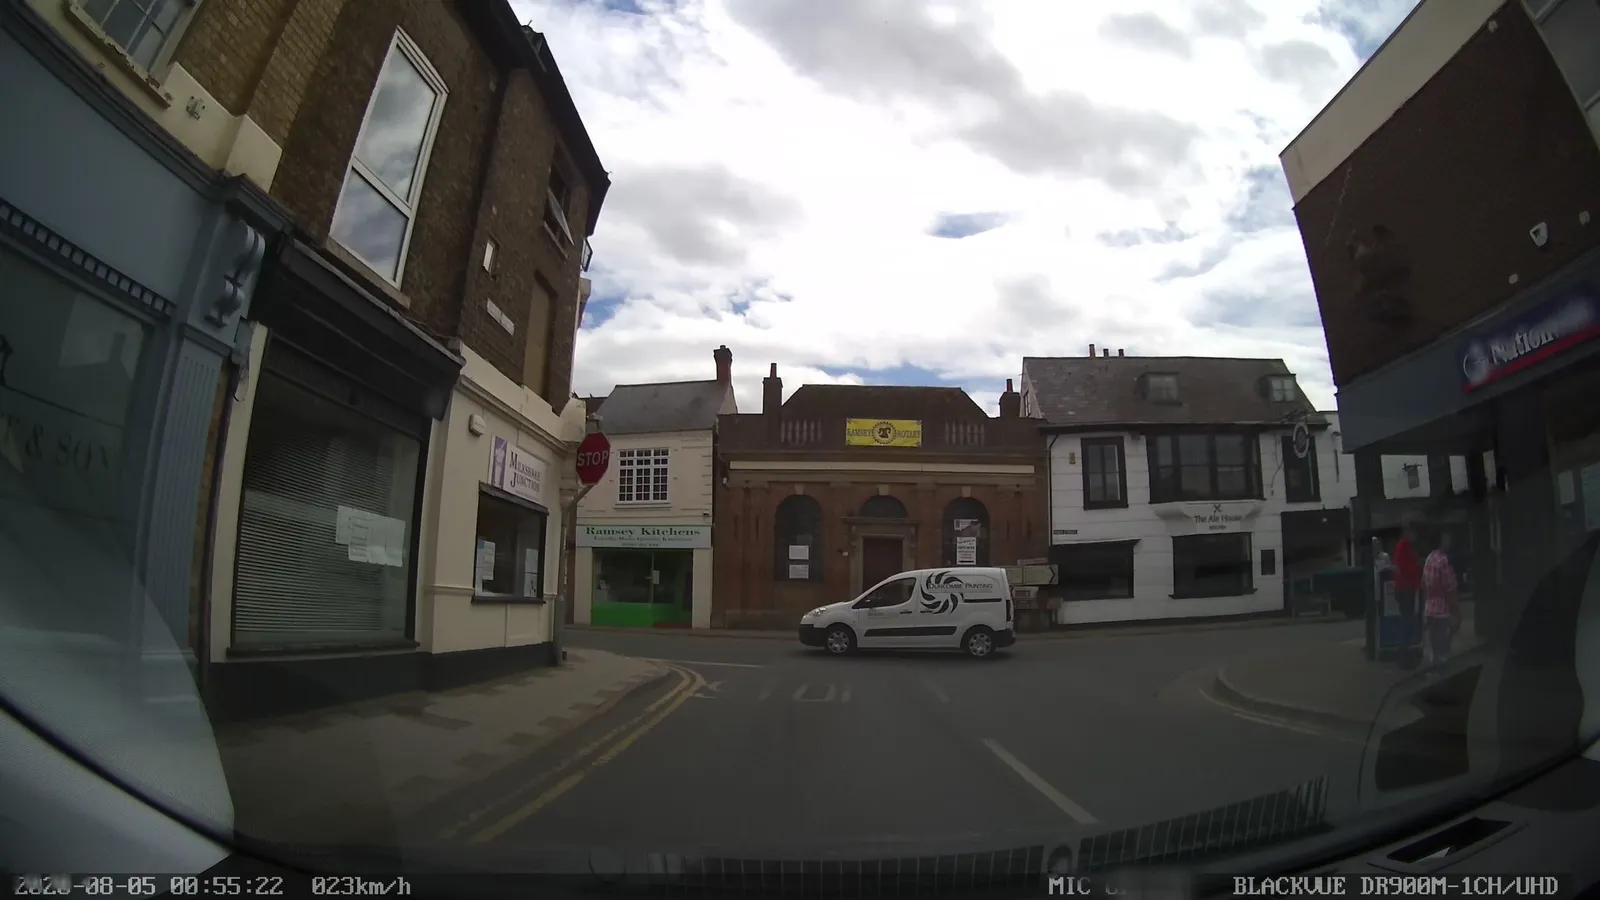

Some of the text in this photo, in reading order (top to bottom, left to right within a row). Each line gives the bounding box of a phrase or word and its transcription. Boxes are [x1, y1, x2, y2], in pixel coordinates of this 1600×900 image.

[846, 428, 871, 437] RAMSEY
[24, 422, 45, 460] &
[577, 450, 609, 467] STOP
[1194, 513, 1242, 523] The Ale House
[586, 527, 701, 538] Ramsey Kitchens
